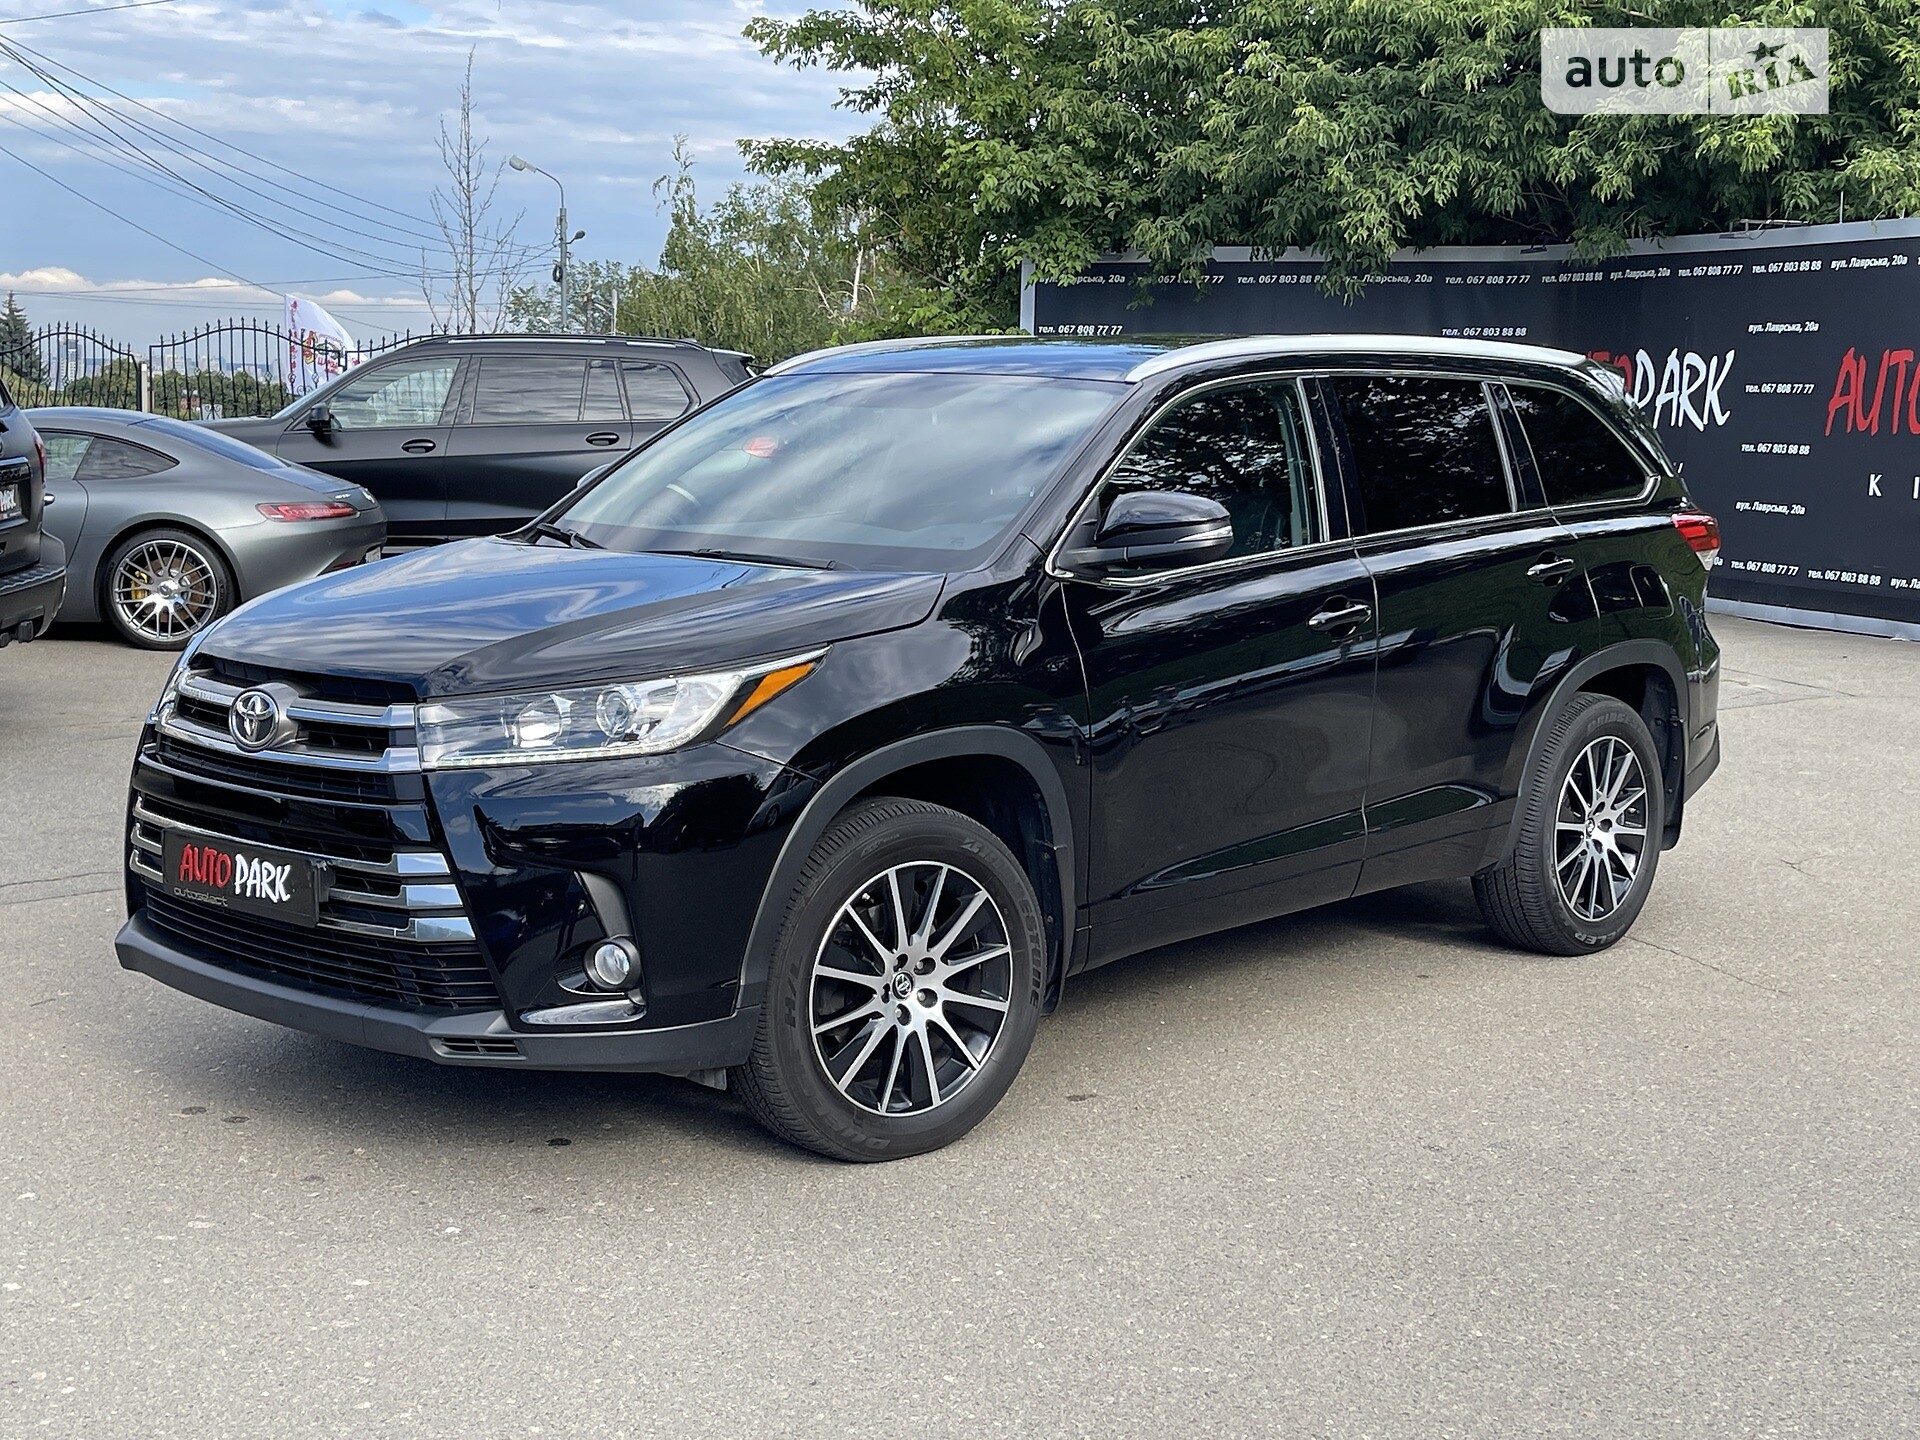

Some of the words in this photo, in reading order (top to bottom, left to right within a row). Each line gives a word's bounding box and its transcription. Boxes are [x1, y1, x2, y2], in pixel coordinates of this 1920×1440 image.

[1752, 265, 1766, 273] тел.
[1768, 263, 1783, 272] 067
[1784, 262, 1798, 272] 803
[1800, 261, 1810, 271] 88
[1811, 261, 1822, 270] 88
[1831, 259, 1847, 270] вул.
[1849, 257, 1890, 269] Лаврська,
[1892, 255, 1908, 265] 20а
[1678, 269, 1692, 277] тел.
[1693, 266, 1707, 276] 067
[1722, 265, 1732, 275] 77
[1732, 265, 1743, 275] 77
[1059, 275, 1105, 285] рська,
[1108, 275, 1125, 283] 20а
[1158, 275, 1176, 283] 067
[1211, 275, 1224, 283] 77
[1237, 276, 1256, 284] тел.
[1259, 275, 1277, 283] 067
[1279, 275, 1297, 283] 803
[1299, 275, 1312, 283] 88
[1414, 274, 1432, 283] 20а
[1445, 276, 1464, 284] тел.
[1467, 275, 1485, 284] 067
[1486, 275, 1504, 284] 808
[1506, 275, 1517, 284] 77
[1518, 275, 1530, 284] 77
[1541, 275, 1557, 283] тел.
[1559, 273, 1571, 282] 067
[1058, 325, 1076, 333] 067
[1077, 325, 1095, 335] 808
[1097, 325, 1108, 335] 77
[1110, 325, 1123, 335] 77
[1442, 328, 1460, 336] тел.
[1463, 328, 1481, 336] 067
[1483, 328, 1500, 336] 803
[1502, 328, 1513, 336] 88
[1515, 328, 1527, 336] 88
[1748, 323, 1763, 334] вул.
[1765, 322, 1802, 334] Лаврська,
[1804, 321, 1819, 332] 20а
[1745, 385, 1759, 393] тел.
[1761, 384, 1776, 393] 067
[1777, 384, 1792, 393] 808
[1792, 384, 1803, 394] 77
[1803, 384, 1814, 394] 77
[1741, 444, 1755, 452] тел.
[1757, 443, 1772, 452] 067
[1772, 444, 1787, 454] 803
[1736, 501, 1751, 511] вул.
[1791, 504, 1805, 514] 20а
[1731, 561, 1745, 569] тел.
[1747, 561, 1761, 571] 067
[1761, 562, 1776, 573] 808
[1777, 565, 1787, 574] 77
[1788, 565, 1799, 576] 77
[1808, 570, 1824, 579] тел.
[1825, 570, 1841, 581] 067
[1841, 571, 1857, 582] 803
[1857, 574, 1869, 584] 88
[1869, 575, 1881, 585] 88
[1890, 578, 1908, 589] вул.
[234, 853, 291, 903] PARK
